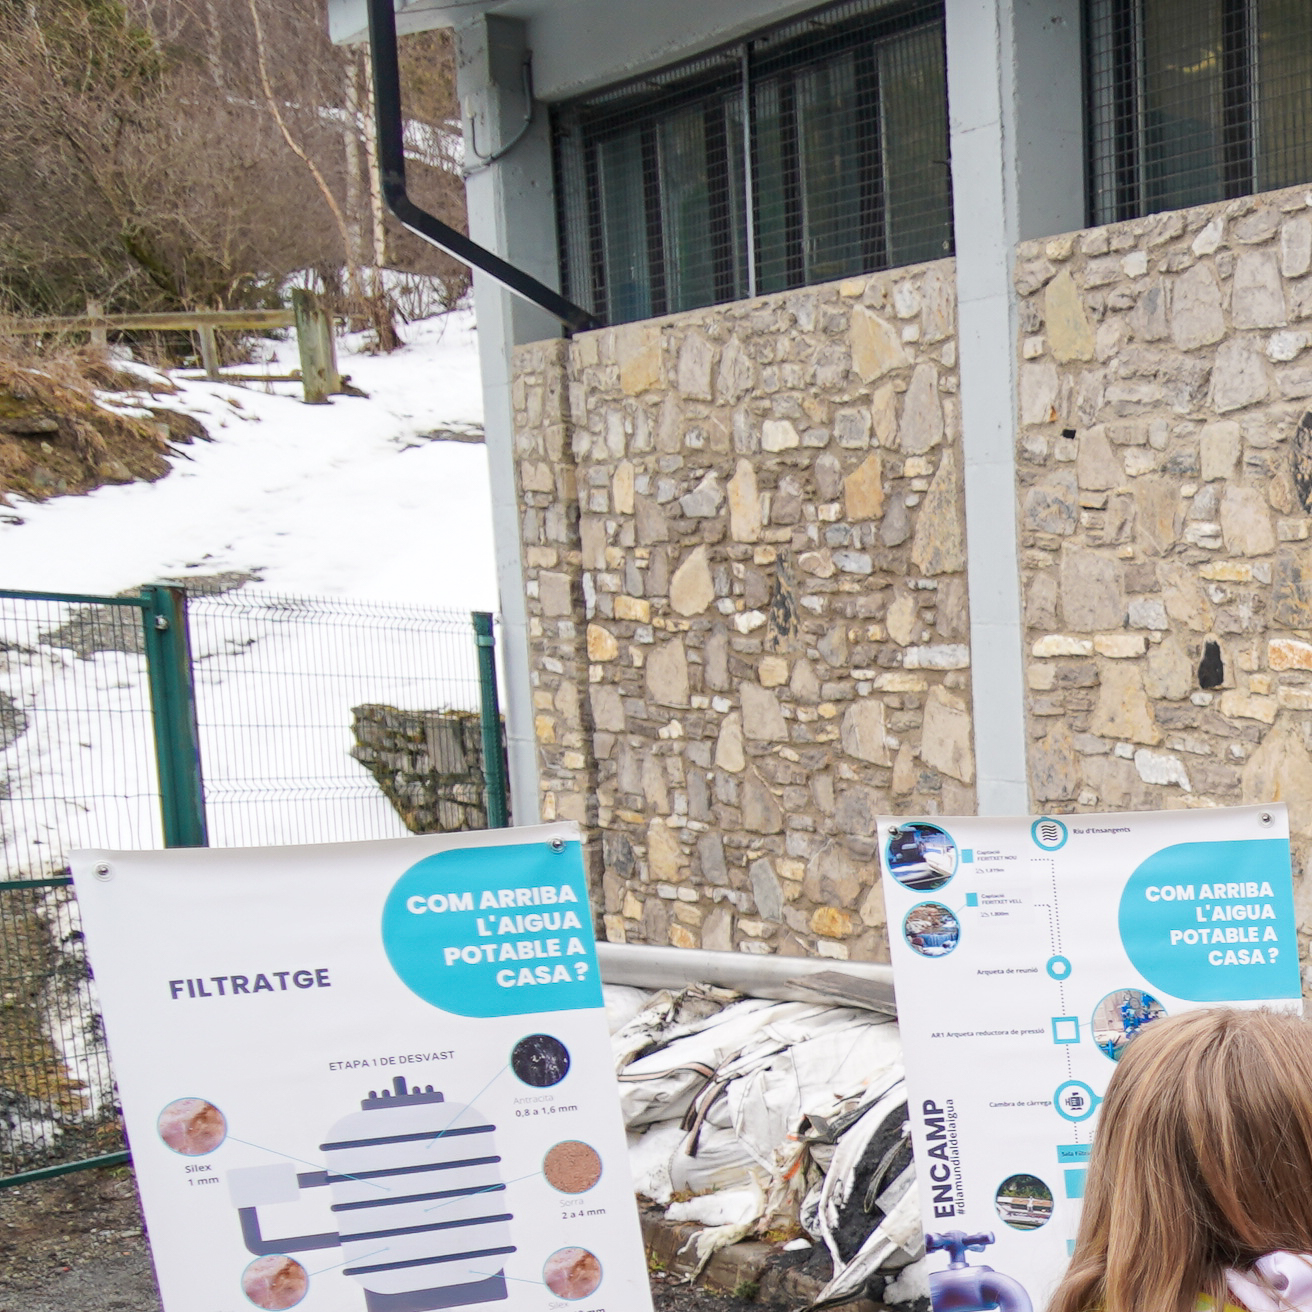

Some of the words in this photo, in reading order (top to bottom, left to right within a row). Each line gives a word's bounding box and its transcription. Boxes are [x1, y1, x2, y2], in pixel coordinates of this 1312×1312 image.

[406, 892, 474, 915] COM
[479, 884, 578, 909] ARRIBA
[1145, 884, 1195, 902] COM
[1198, 881, 1275, 900] ARRIBA
[476, 910, 582, 936] L'AIGUA
[1196, 903, 1277, 922] L'AIGUA
[1170, 926, 1259, 945] POTABLE
[1262, 926, 1278, 942] A
[443, 938, 562, 966] POTABLE
[566, 937, 586, 955] A
[1208, 949, 1266, 966] CASA
[169, 968, 331, 1000] FILTRATGE
[496, 964, 572, 988] CASA
[329, 1059, 369, 1071] ETAPA
[372, 1058, 377, 1067] 1
[380, 1056, 397, 1066] DE
[398, 1050, 455, 1064] DESVAST
[513, 1094, 554, 1105] Antracita
[515, 1109, 530, 1118] 0,8
[542, 1106, 556, 1115] 1,6
[558, 1104, 578, 1112] mm
[923, 1099, 955, 1218] ENCAMP
[946, 1099, 966, 1215] #diamundialdelaigua
[197, 1176, 220, 1185] mm
[560, 1198, 584, 1207] Sorra
[587, 1208, 606, 1216] mm
